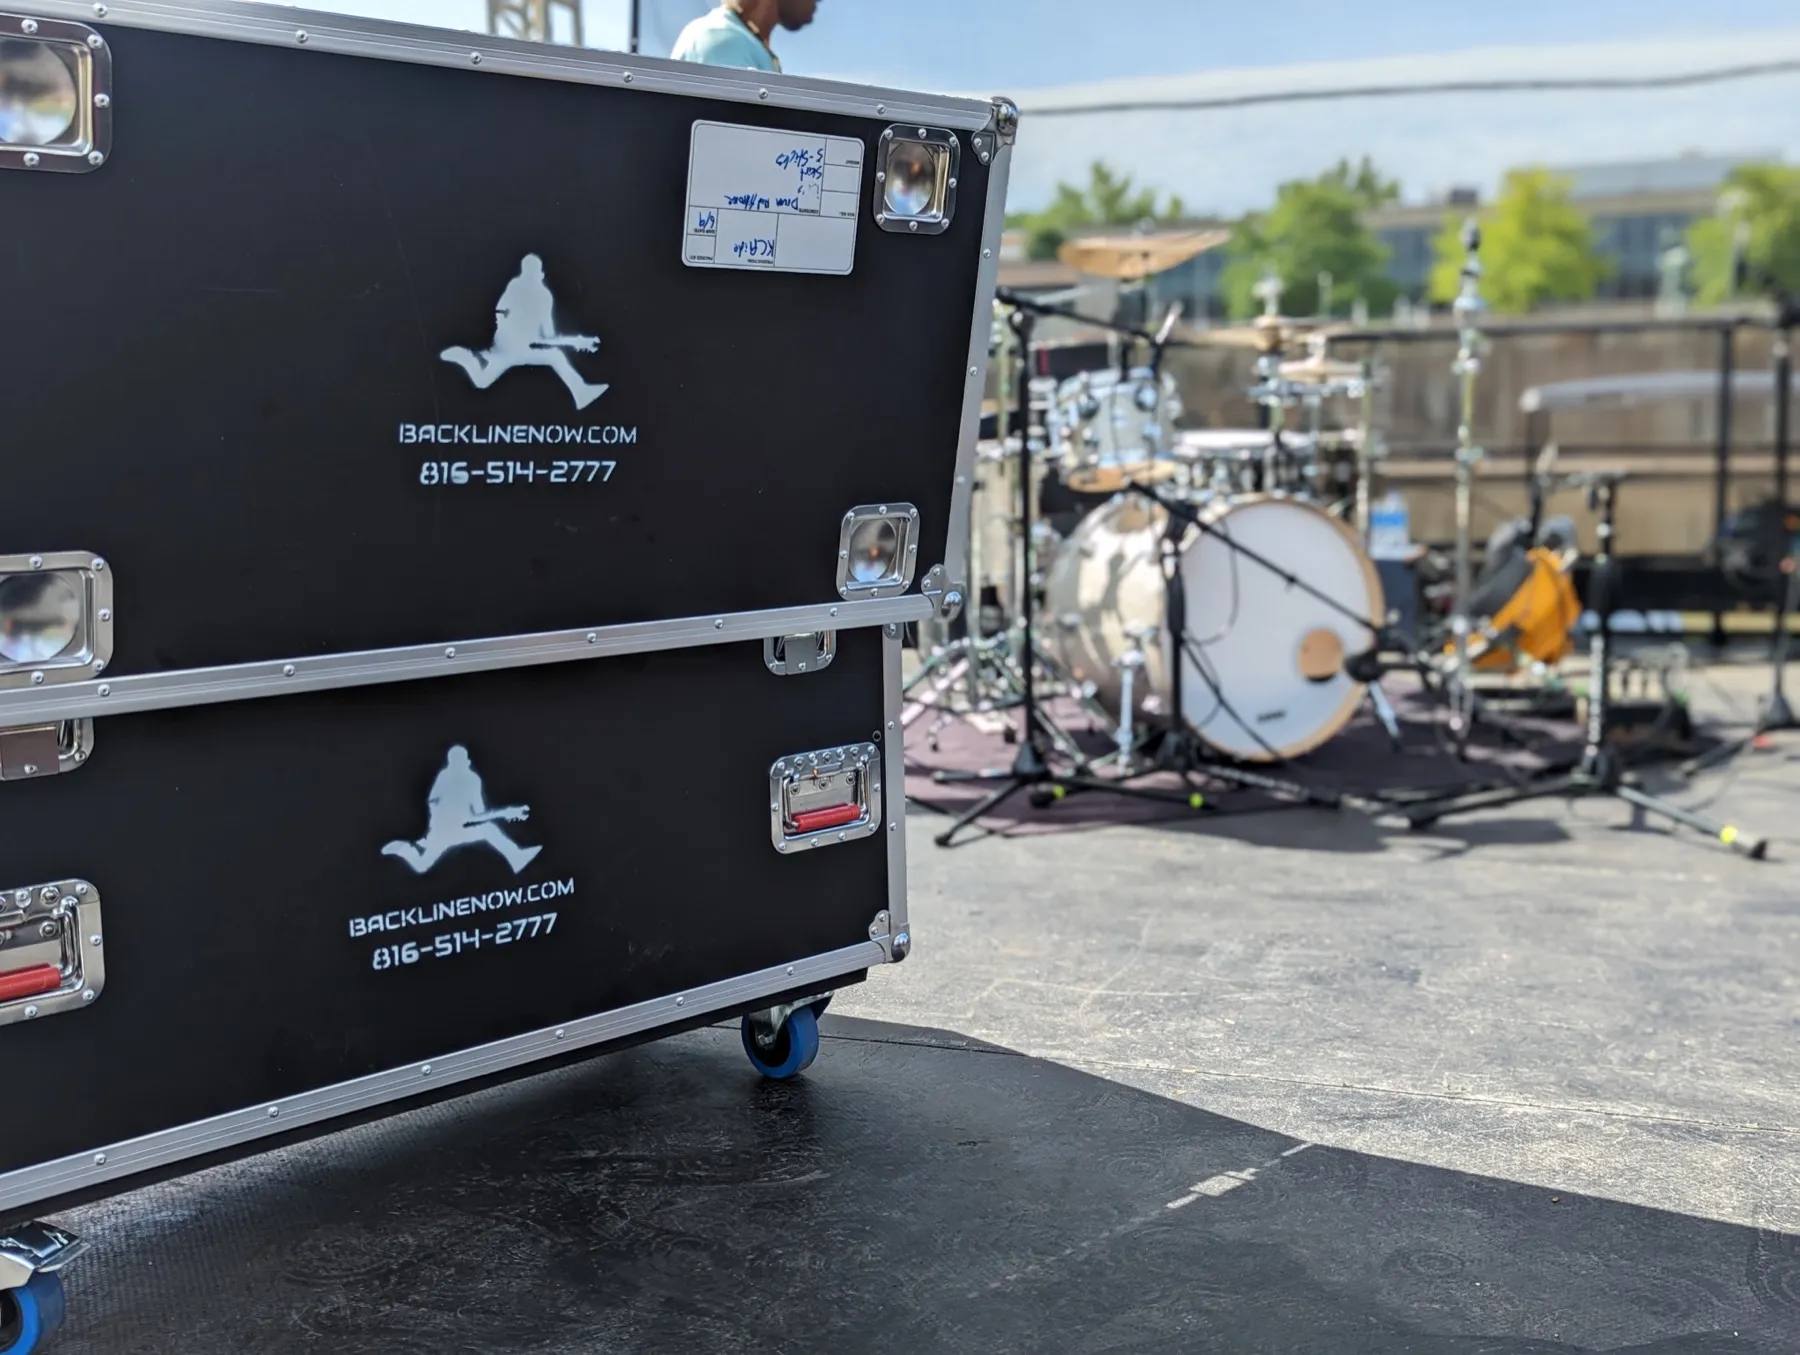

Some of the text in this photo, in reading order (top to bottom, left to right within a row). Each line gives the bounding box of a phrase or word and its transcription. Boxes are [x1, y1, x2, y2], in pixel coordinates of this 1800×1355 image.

[776, 198, 799, 210] Drum
[699, 212, 715, 228] 6/9
[399, 423, 637, 444] BACKLINENOW.COM
[419, 461, 617, 485] 816-514-2777
[349, 878, 575, 937] BACKLINENOW.COM
[372, 912, 558, 970] 816-514-2777
